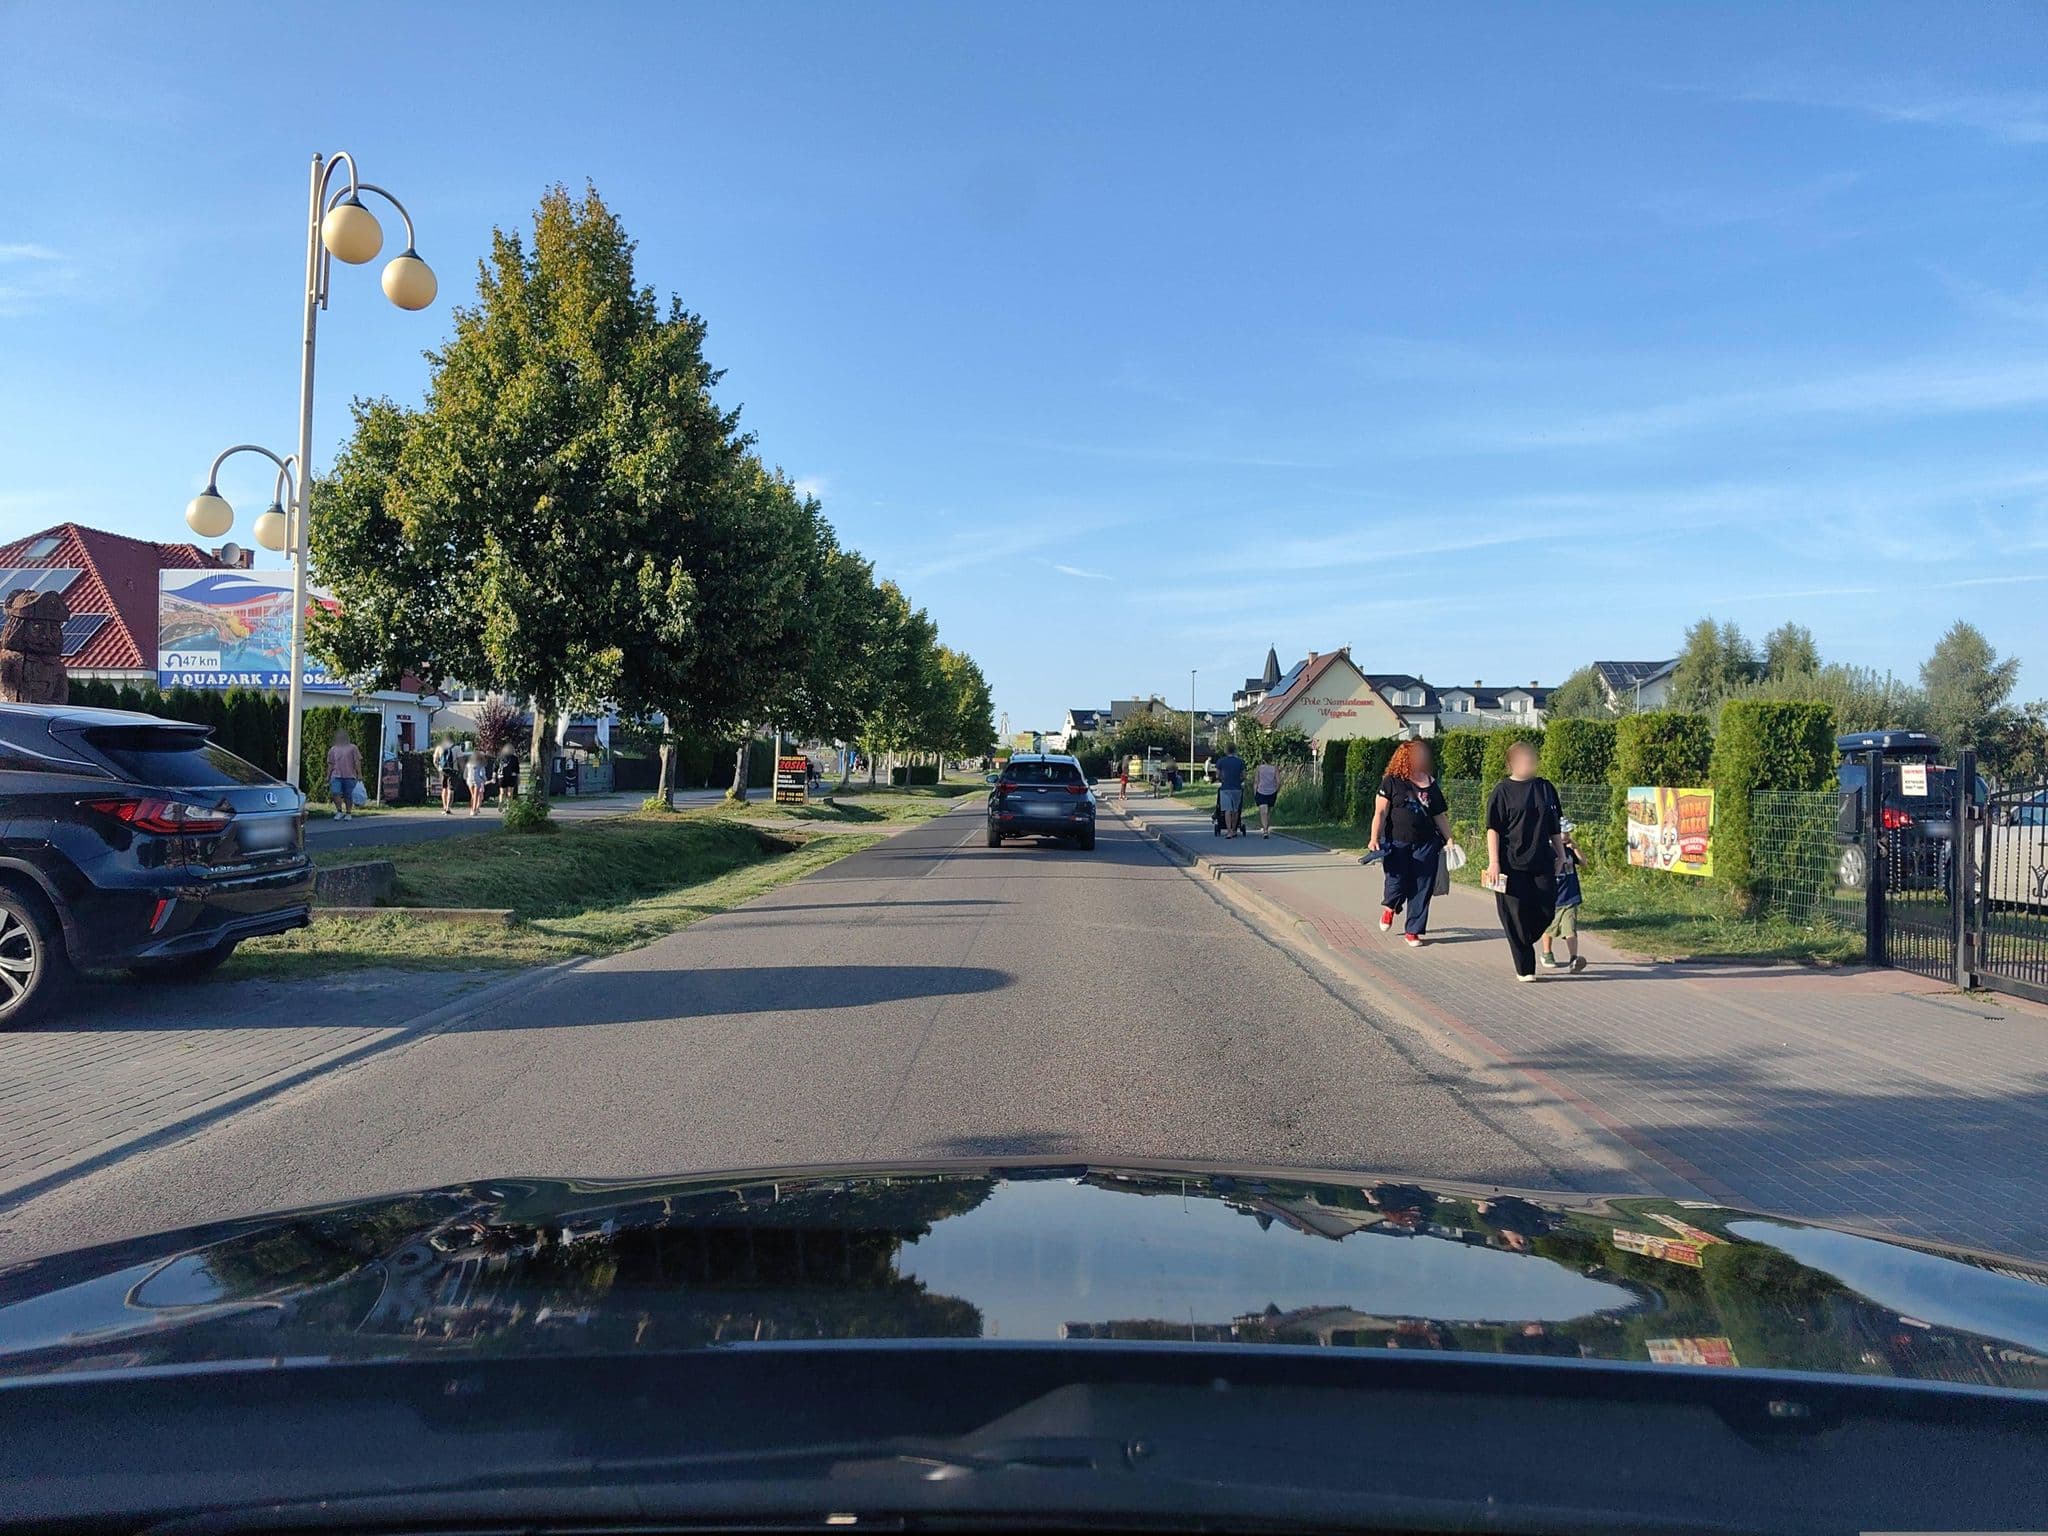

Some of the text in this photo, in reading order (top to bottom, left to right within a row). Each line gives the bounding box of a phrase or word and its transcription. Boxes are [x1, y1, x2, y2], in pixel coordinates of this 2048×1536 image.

[182, 655, 218, 667] 47 km
[170, 673, 263, 687] AQUAPARK
[778, 760, 807, 770] ZOSIA
